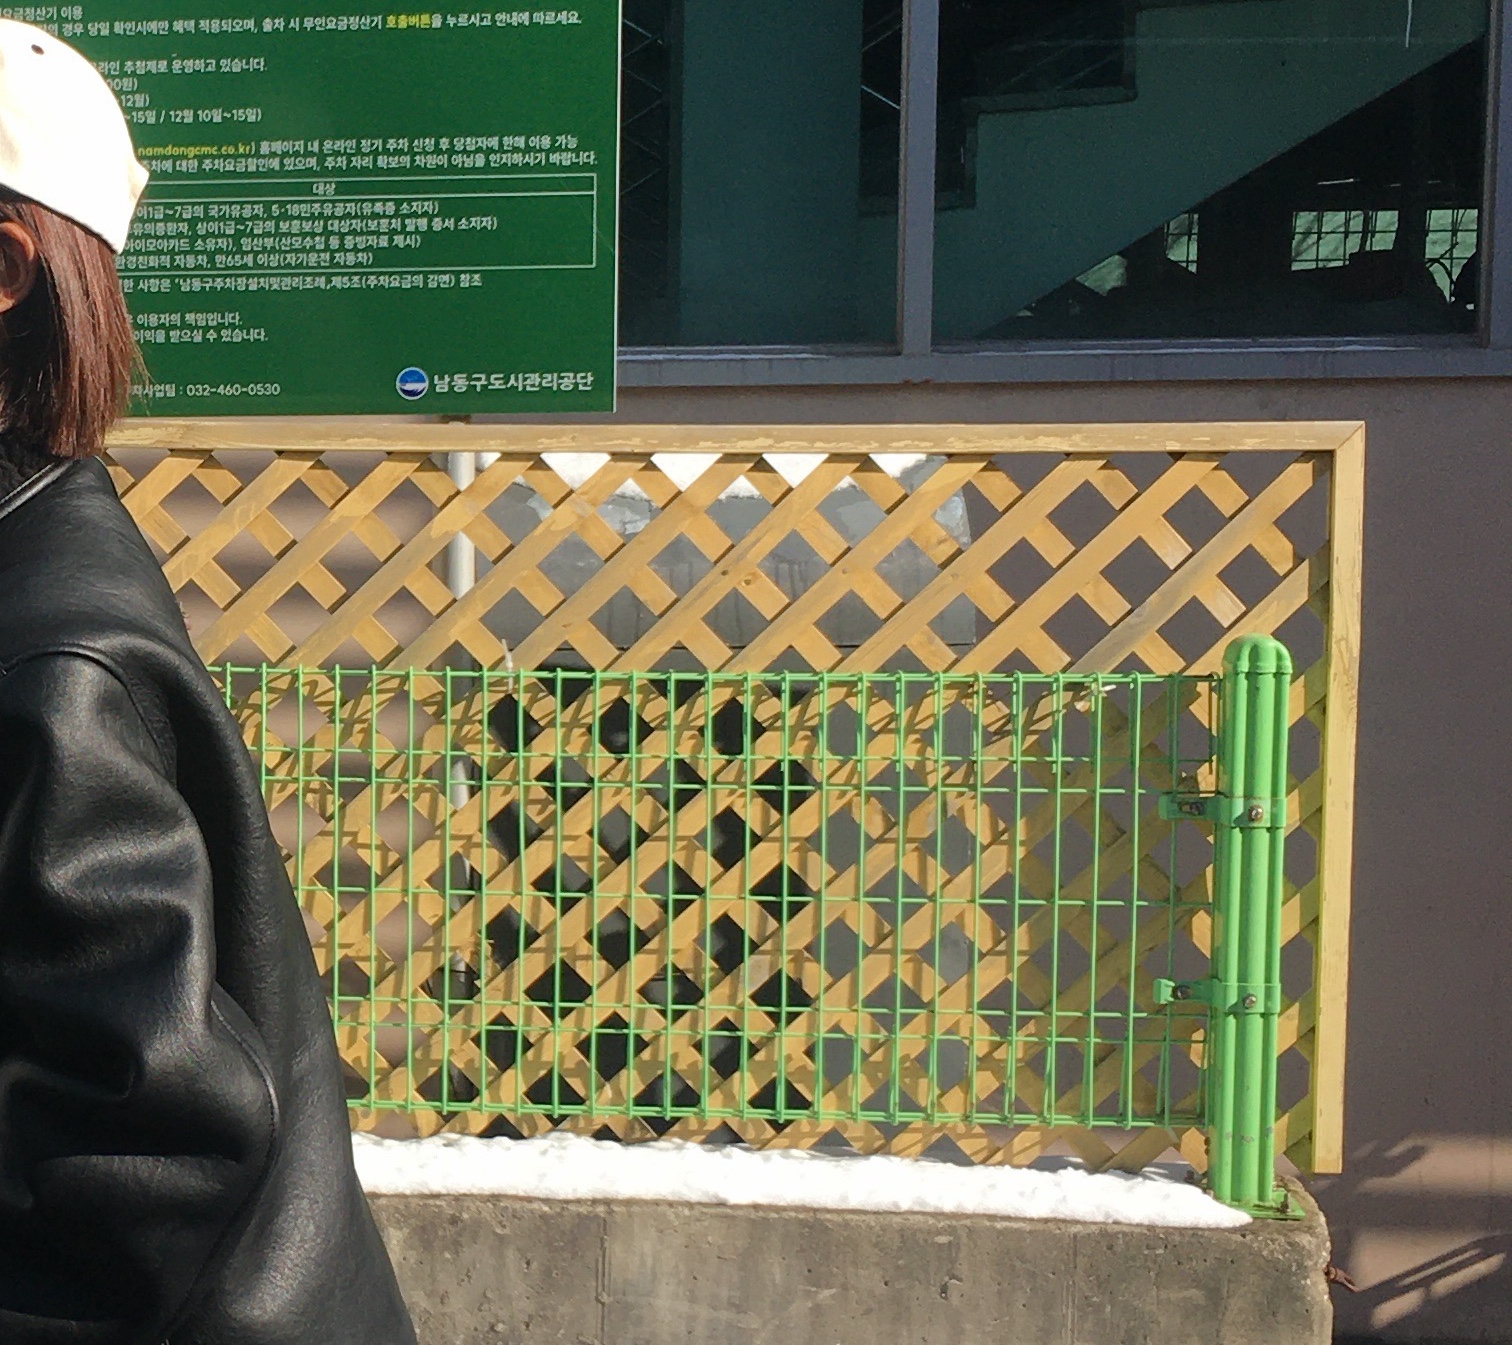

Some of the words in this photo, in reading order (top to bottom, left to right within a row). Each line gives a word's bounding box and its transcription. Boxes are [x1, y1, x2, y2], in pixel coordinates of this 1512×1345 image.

[60, 6, 84, 21] 이용
[62, 22, 84, 37] 경우
[88, 21, 110, 37] 당일
[114, 20, 169, 36] 확인시에만
[173, 19, 195, 34] 혜택
[198, 16, 258, 34] 적용되오며,
[262, 17, 285, 33] 출차
[288, 16, 300, 32] 시
[303, 15, 382, 32] 무인요금정산기
[386, 12, 443, 29] 호출버튼을
[446, 12, 492, 28] 누르시고
[495, 11, 530, 27] 안내에
[533, 10, 582, 26] 따르세요.
[124, 58, 169, 75] 추첨제로
[171, 58, 216, 74] 운영하고
[220, 57, 268, 73] 있습니다.
[169, 109, 193, 124] 12월
[259, 139, 304, 154] 홈페이지
[307, 139, 320, 154] 내
[322, 138, 356, 153] 온라인
[360, 137, 383, 153] 정기
[386, 137, 409, 153] 주차
[413, 136, 436, 152] 신청
[438, 136, 450, 151] 후
[453, 136, 499, 151] 당첨자에
[502, 135, 525, 150] 한해
[528, 135, 551, 150] 이용
[554, 134, 579, 149] 가능
[176, 158, 199, 174] 대한
[201, 156, 280, 173] 주차요금할인에
[283, 155, 321, 172] 있으며,
[324, 155, 347, 170] 주차
[350, 154, 373, 169] 자리
[377, 154, 411, 169] 확보의
[414, 153, 448, 169] 차원이
[451, 153, 485, 168] 아님을
[489, 151, 546, 167] 인지하시기
[549, 150, 598, 166] 바랍니다.
[312, 181, 336, 196] 대상
[208, 203, 267, 219] 국가유공자,
[398, 200, 439, 215] 소지자)
[458, 216, 498, 231] 소지자)
[194, 236, 237, 252] 소유자),
[392, 234, 421, 249] 제시)
[173, 254, 211, 269] 자동차,
[215, 253, 254, 268] 만65세
[333, 252, 373, 266] 자동차)
[138, 277, 171, 293] 사항은
[459, 273, 483, 288] 참조
[137, 312, 181, 327] 이용자의
[185, 311, 243, 327] 책임입니다.
[169, 328, 203, 343] 받으실
[206, 329, 218, 343] 수
[220, 327, 269, 343] 있습니다.
[186, 383, 281, 397] 032-460-0530
[433, 371, 594, 393] 남동구도시관리공단
